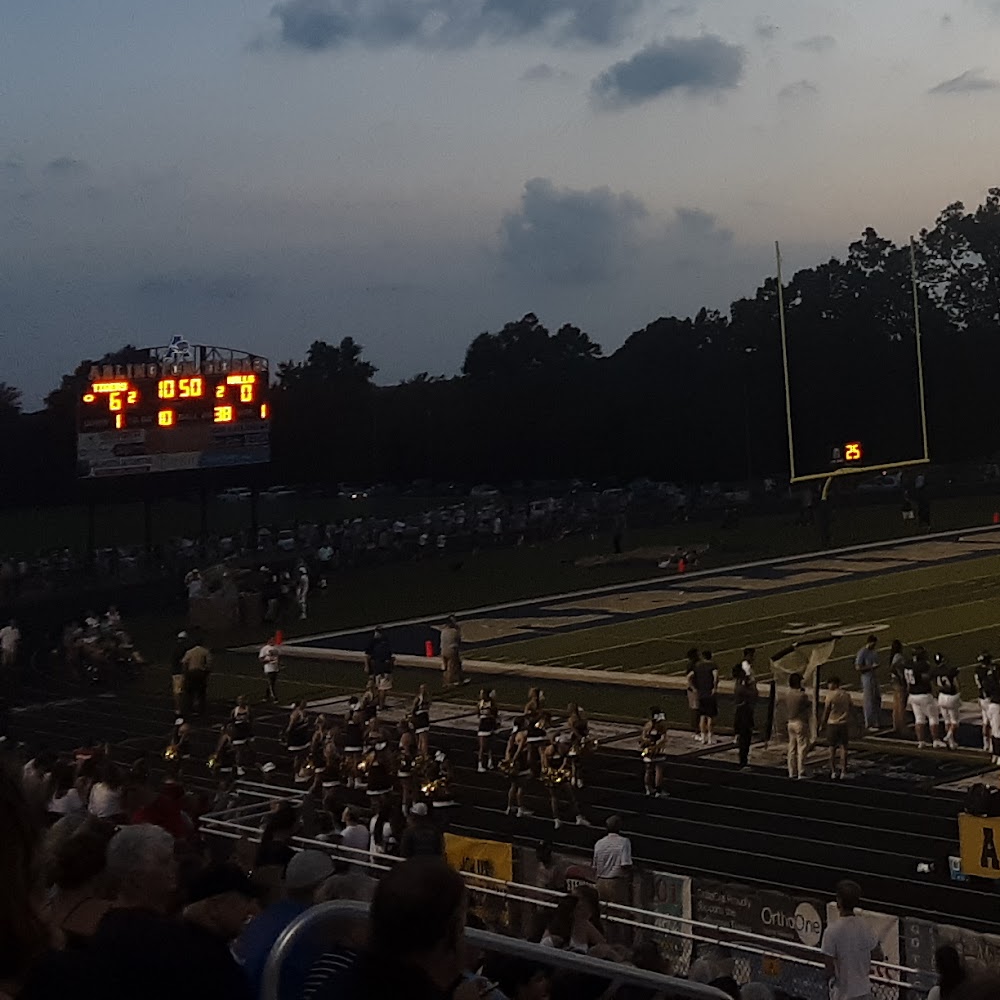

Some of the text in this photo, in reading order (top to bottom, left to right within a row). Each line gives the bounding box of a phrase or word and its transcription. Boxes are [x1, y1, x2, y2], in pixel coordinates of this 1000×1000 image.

[109, 392, 122, 411] 6
[240, 384, 253, 403] 0
[214, 406, 233, 422] 38
[261, 404, 267, 419] 1
[116, 414, 121, 429] 1
[845, 444, 861, 461] 25
[980, 827, 1000, 870] A
